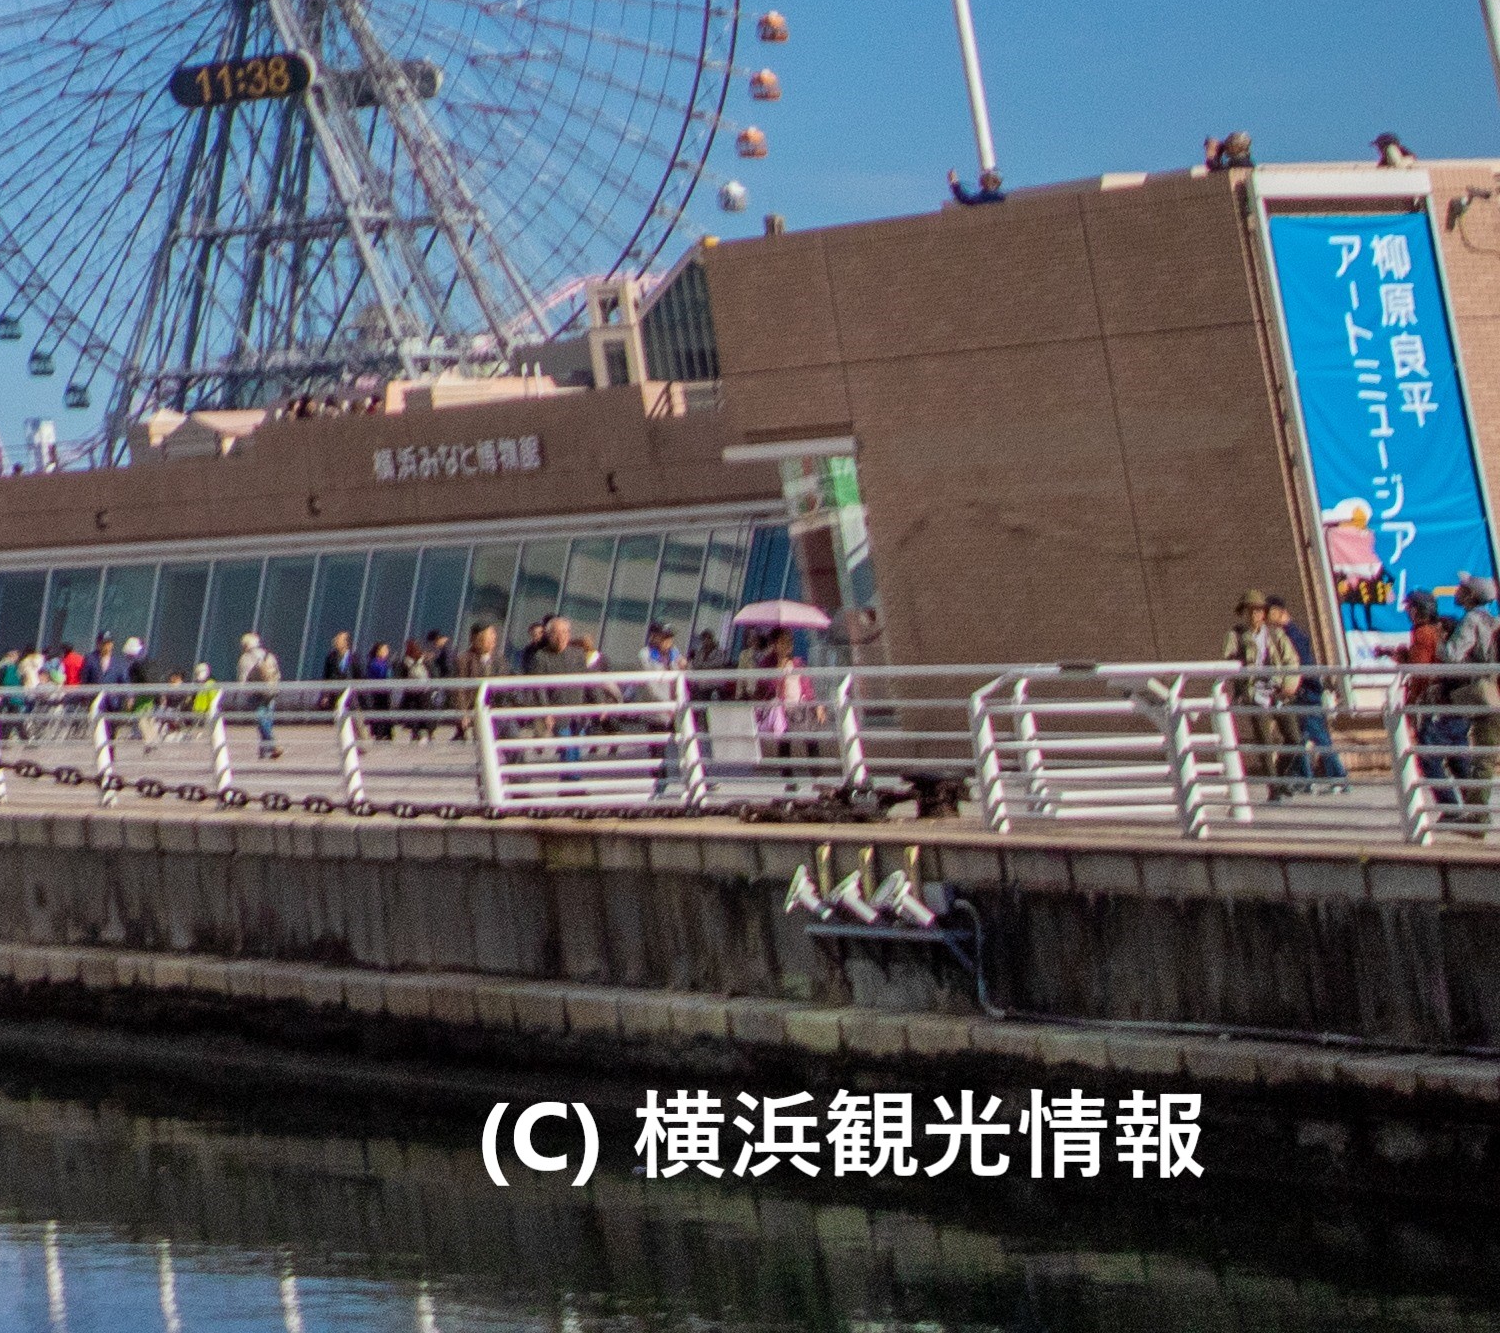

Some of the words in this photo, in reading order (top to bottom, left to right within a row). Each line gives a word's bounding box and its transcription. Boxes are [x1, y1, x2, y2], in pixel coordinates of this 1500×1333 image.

[195, 56, 290, 103] 11:38
[1370, 233, 1438, 427] 柳原良平
